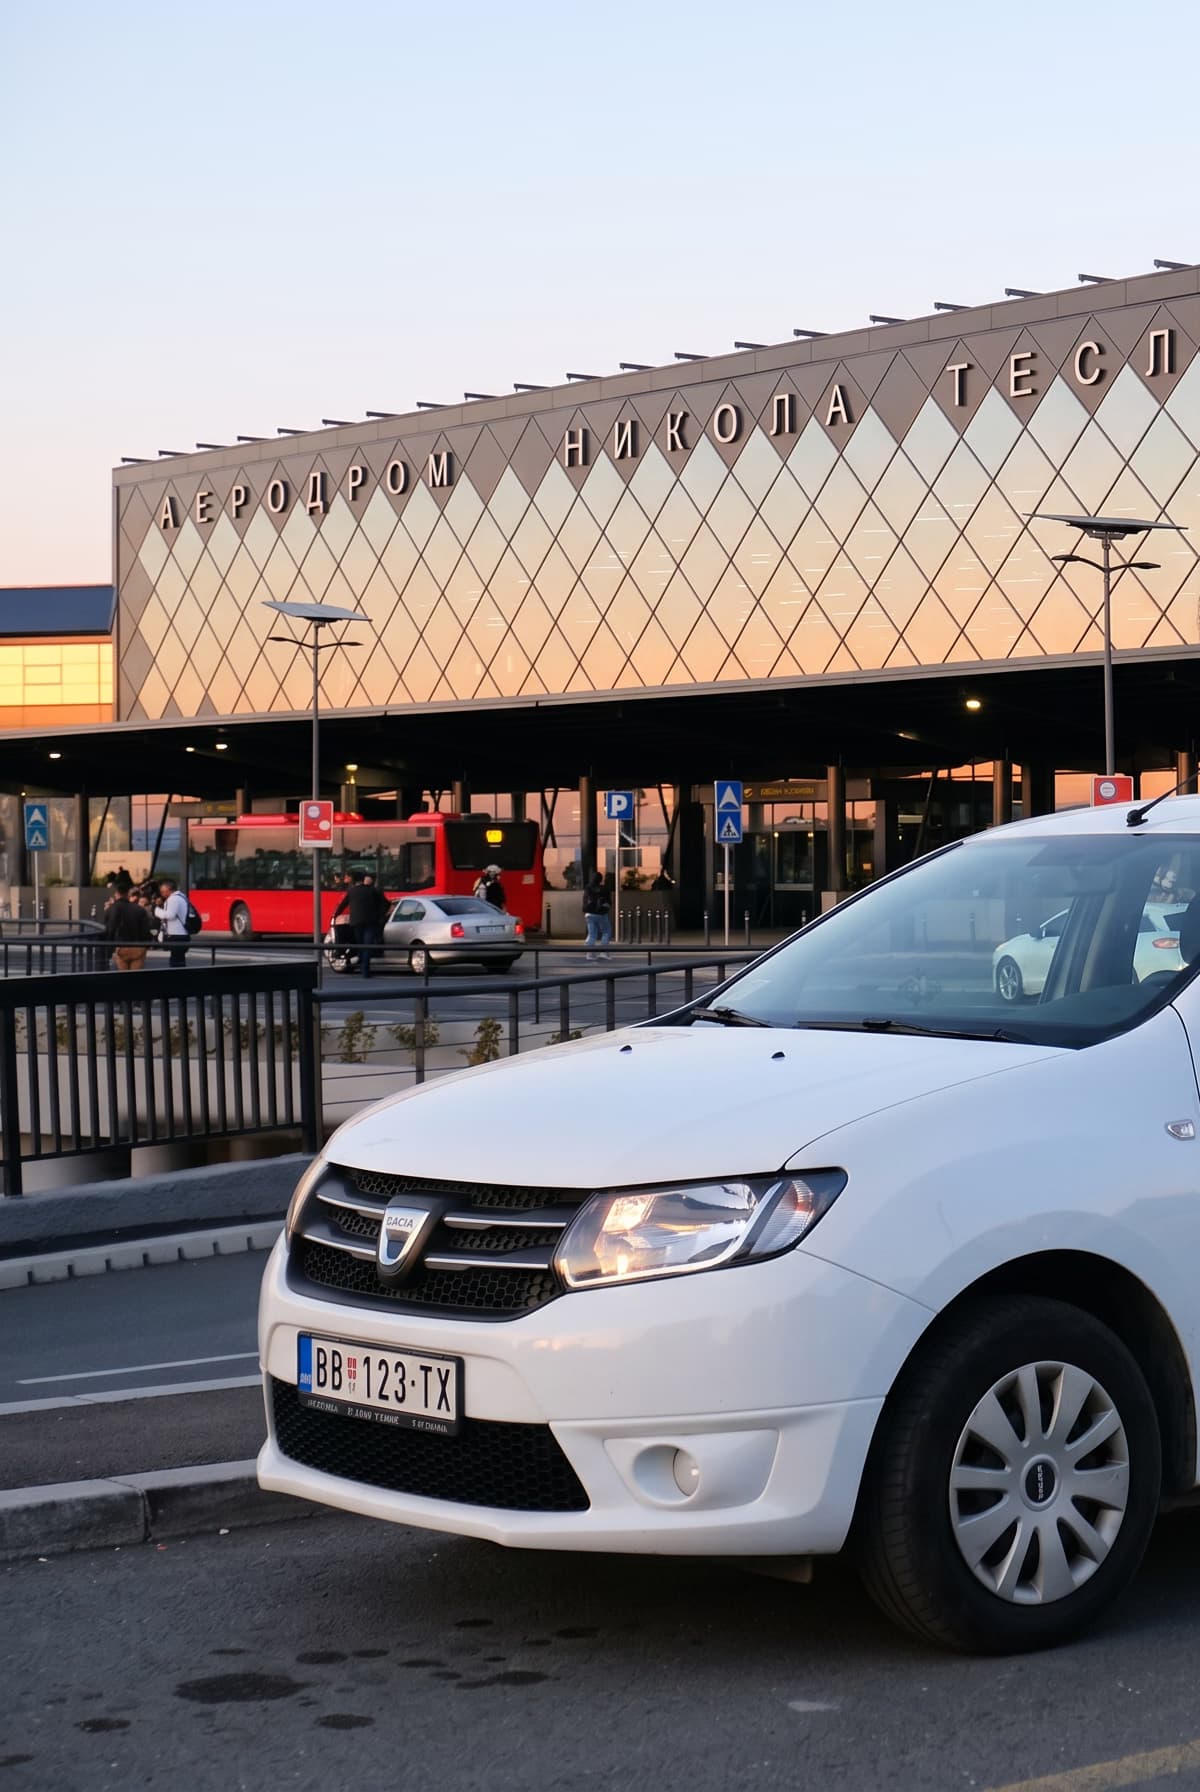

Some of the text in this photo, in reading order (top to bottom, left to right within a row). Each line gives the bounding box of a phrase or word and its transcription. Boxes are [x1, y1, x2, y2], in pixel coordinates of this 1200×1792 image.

[160, 451, 453, 529] АЕРОДРОМ
[565, 384, 852, 467] НИКОЛА
[610, 794, 628, 816] P
[316, 1347, 343, 1391] BB
